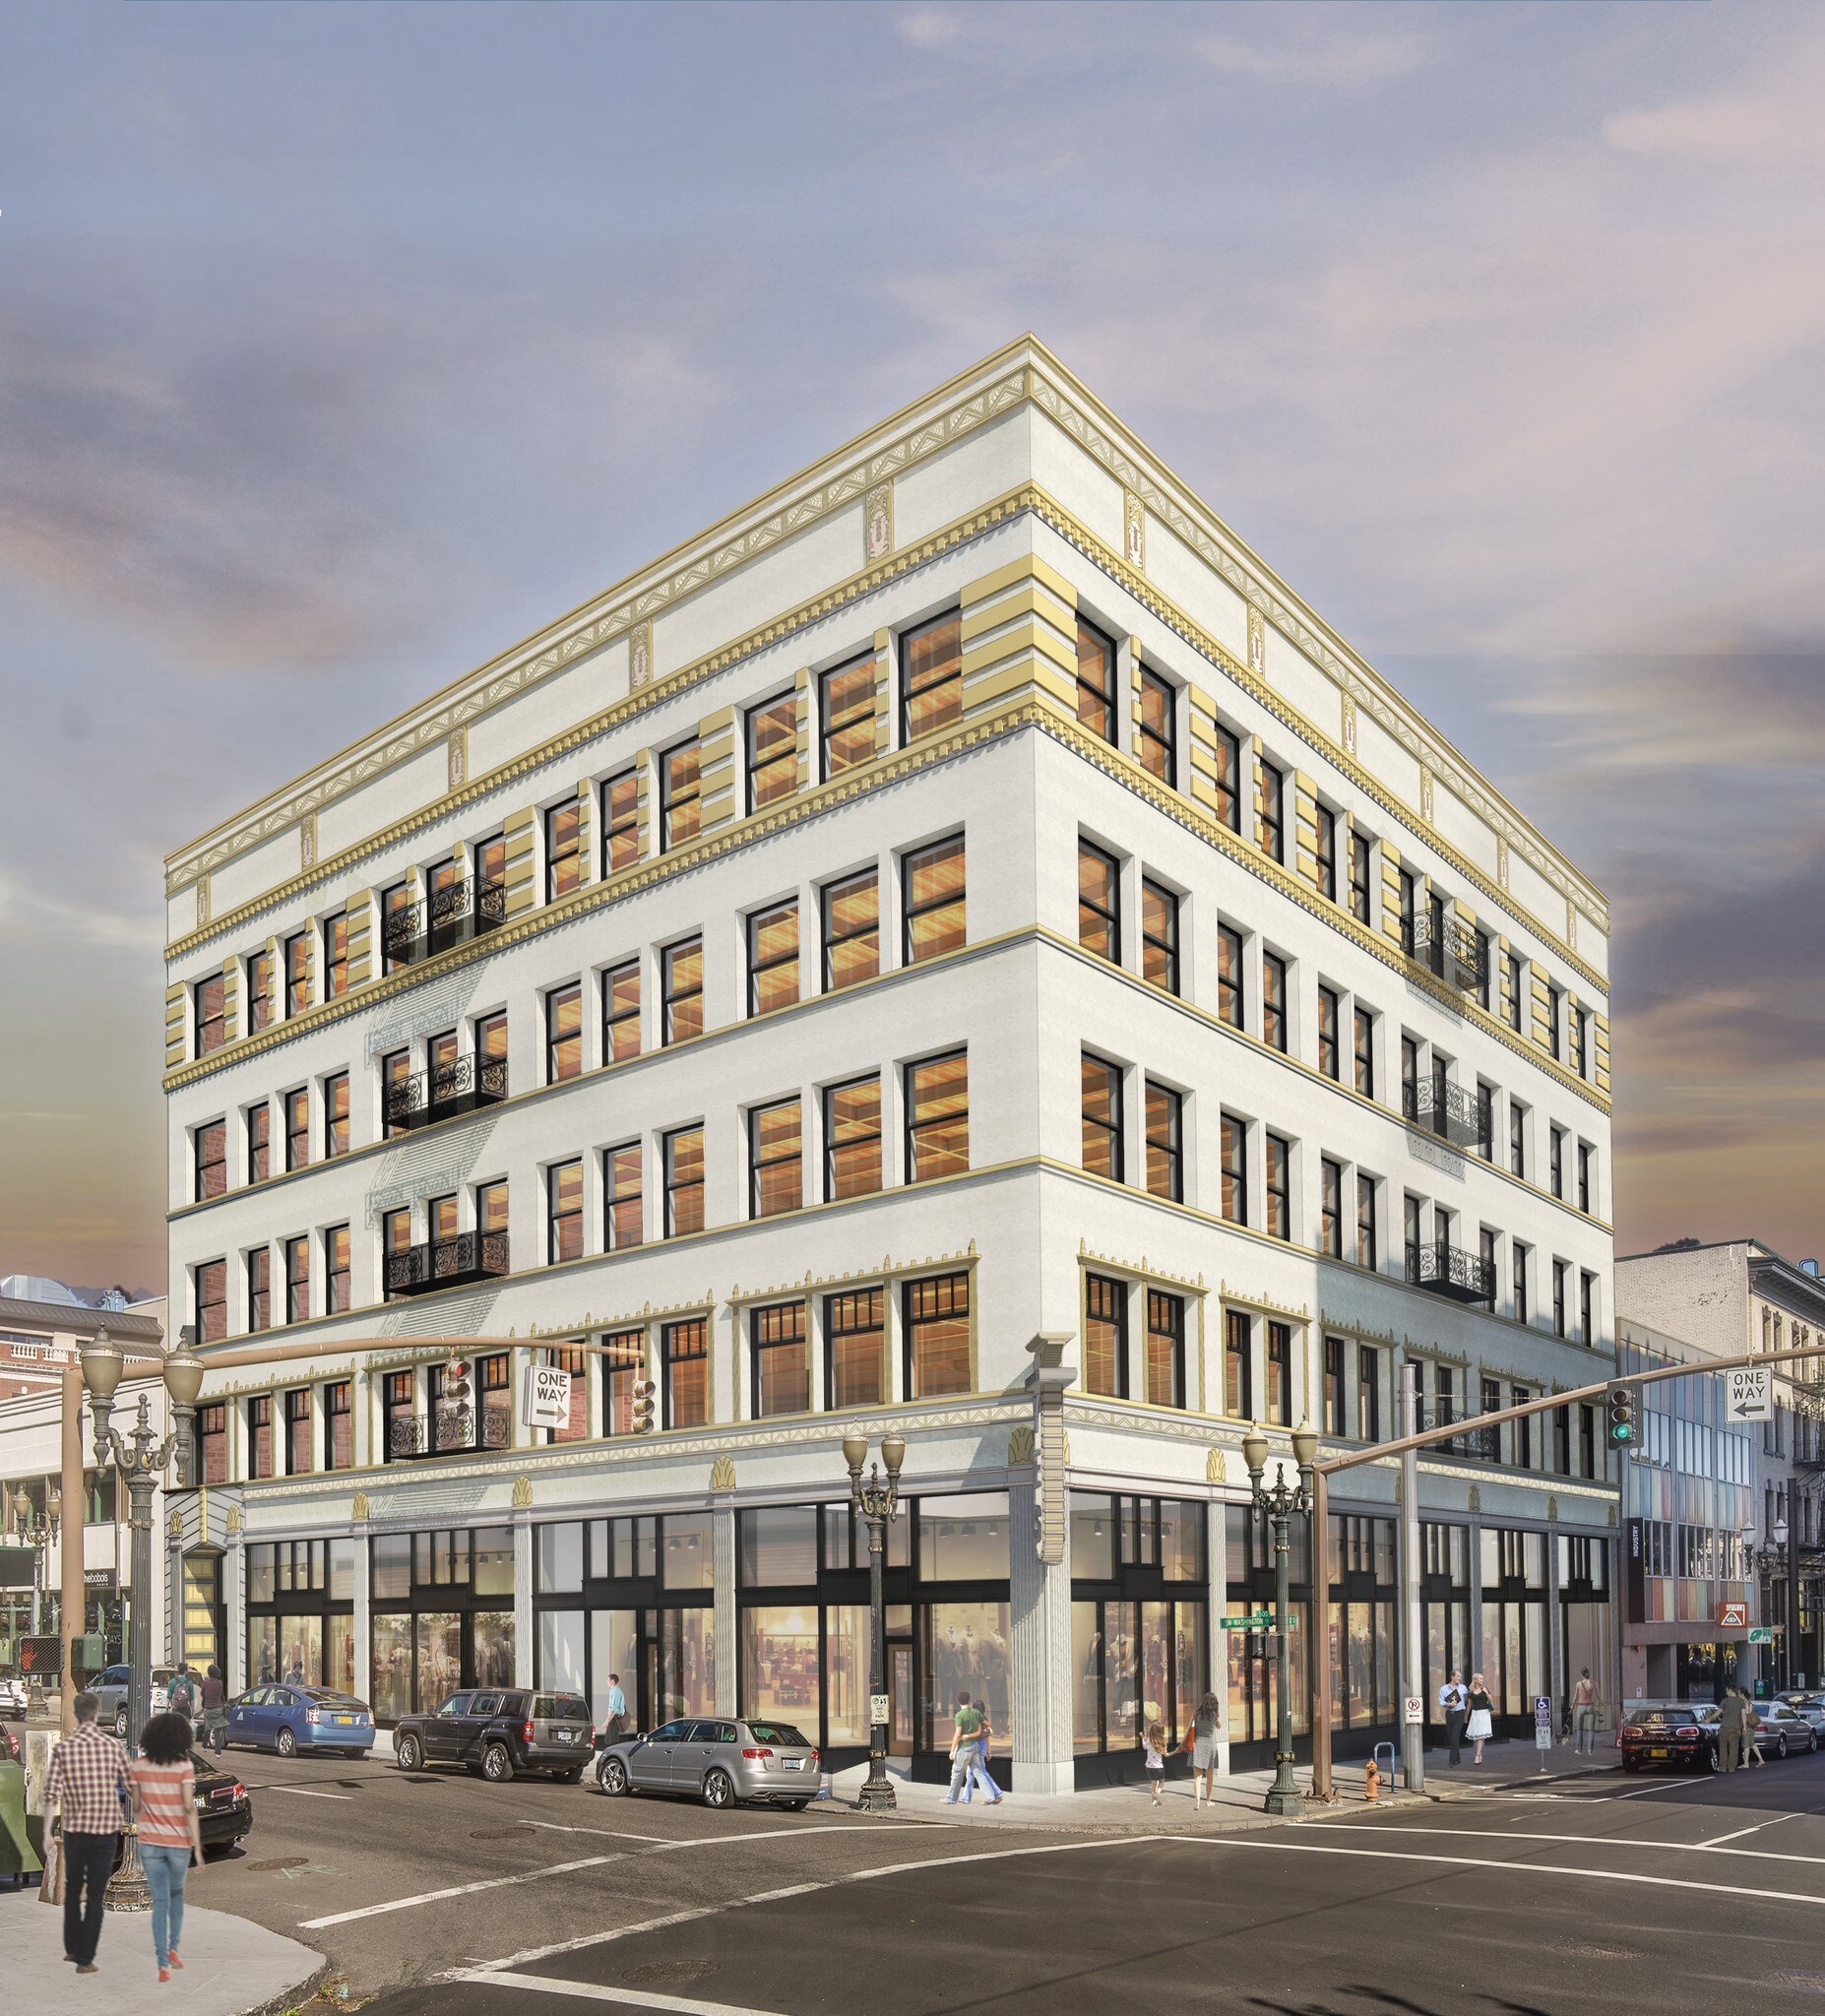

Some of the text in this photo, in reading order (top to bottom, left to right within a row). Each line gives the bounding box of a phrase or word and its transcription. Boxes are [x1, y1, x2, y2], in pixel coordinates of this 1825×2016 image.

[538, 1372, 567, 1387] ONE
[1734, 1372, 1764, 1385] ONE
[537, 1387, 567, 1402] WAY
[1733, 1386, 1765, 1400] WAY
[1233, 1617, 1264, 1626] WASHINGTON
